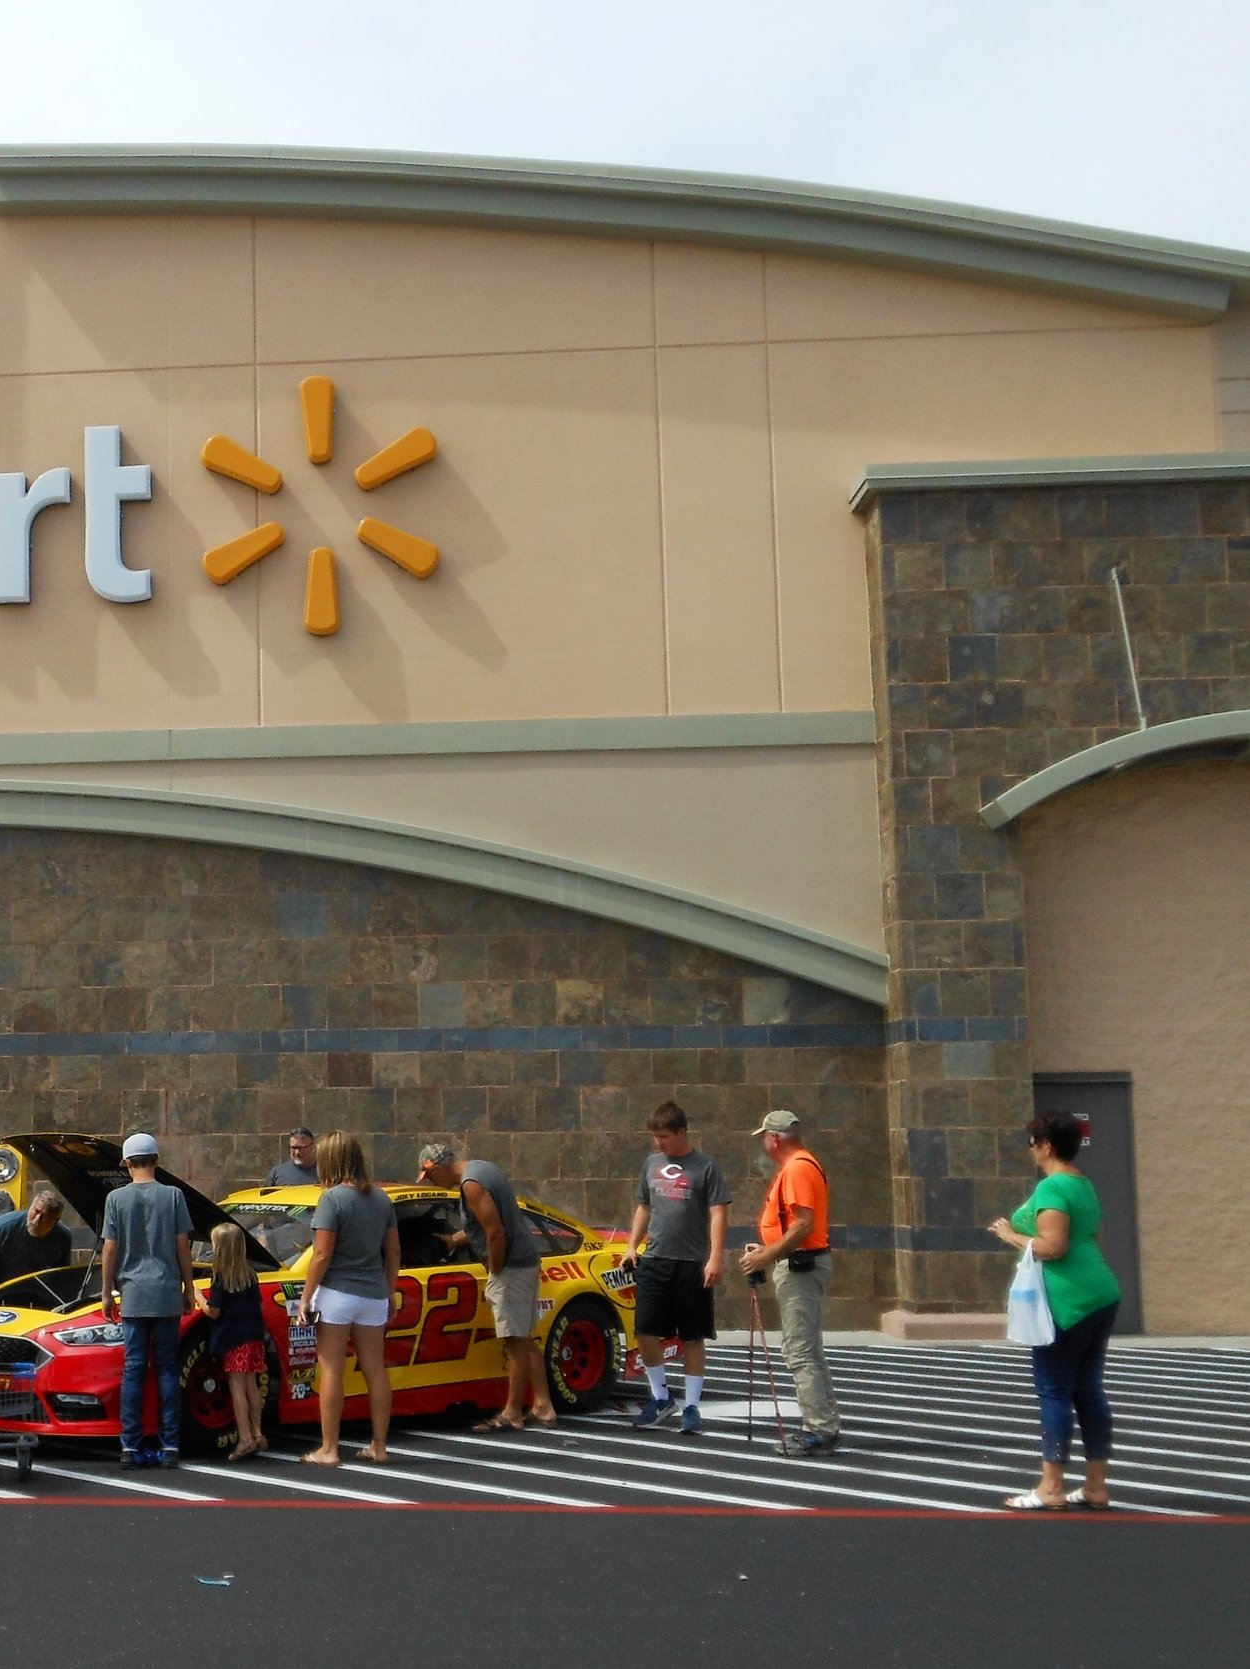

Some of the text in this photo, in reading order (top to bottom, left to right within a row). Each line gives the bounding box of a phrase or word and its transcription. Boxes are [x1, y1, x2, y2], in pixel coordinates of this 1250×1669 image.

[395, 1193, 415, 1201] JOEY
[540, 1261, 586, 1283] ell
[290, 1327, 316, 1338] MAHL
[179, 1341, 206, 1388] EAGLE
